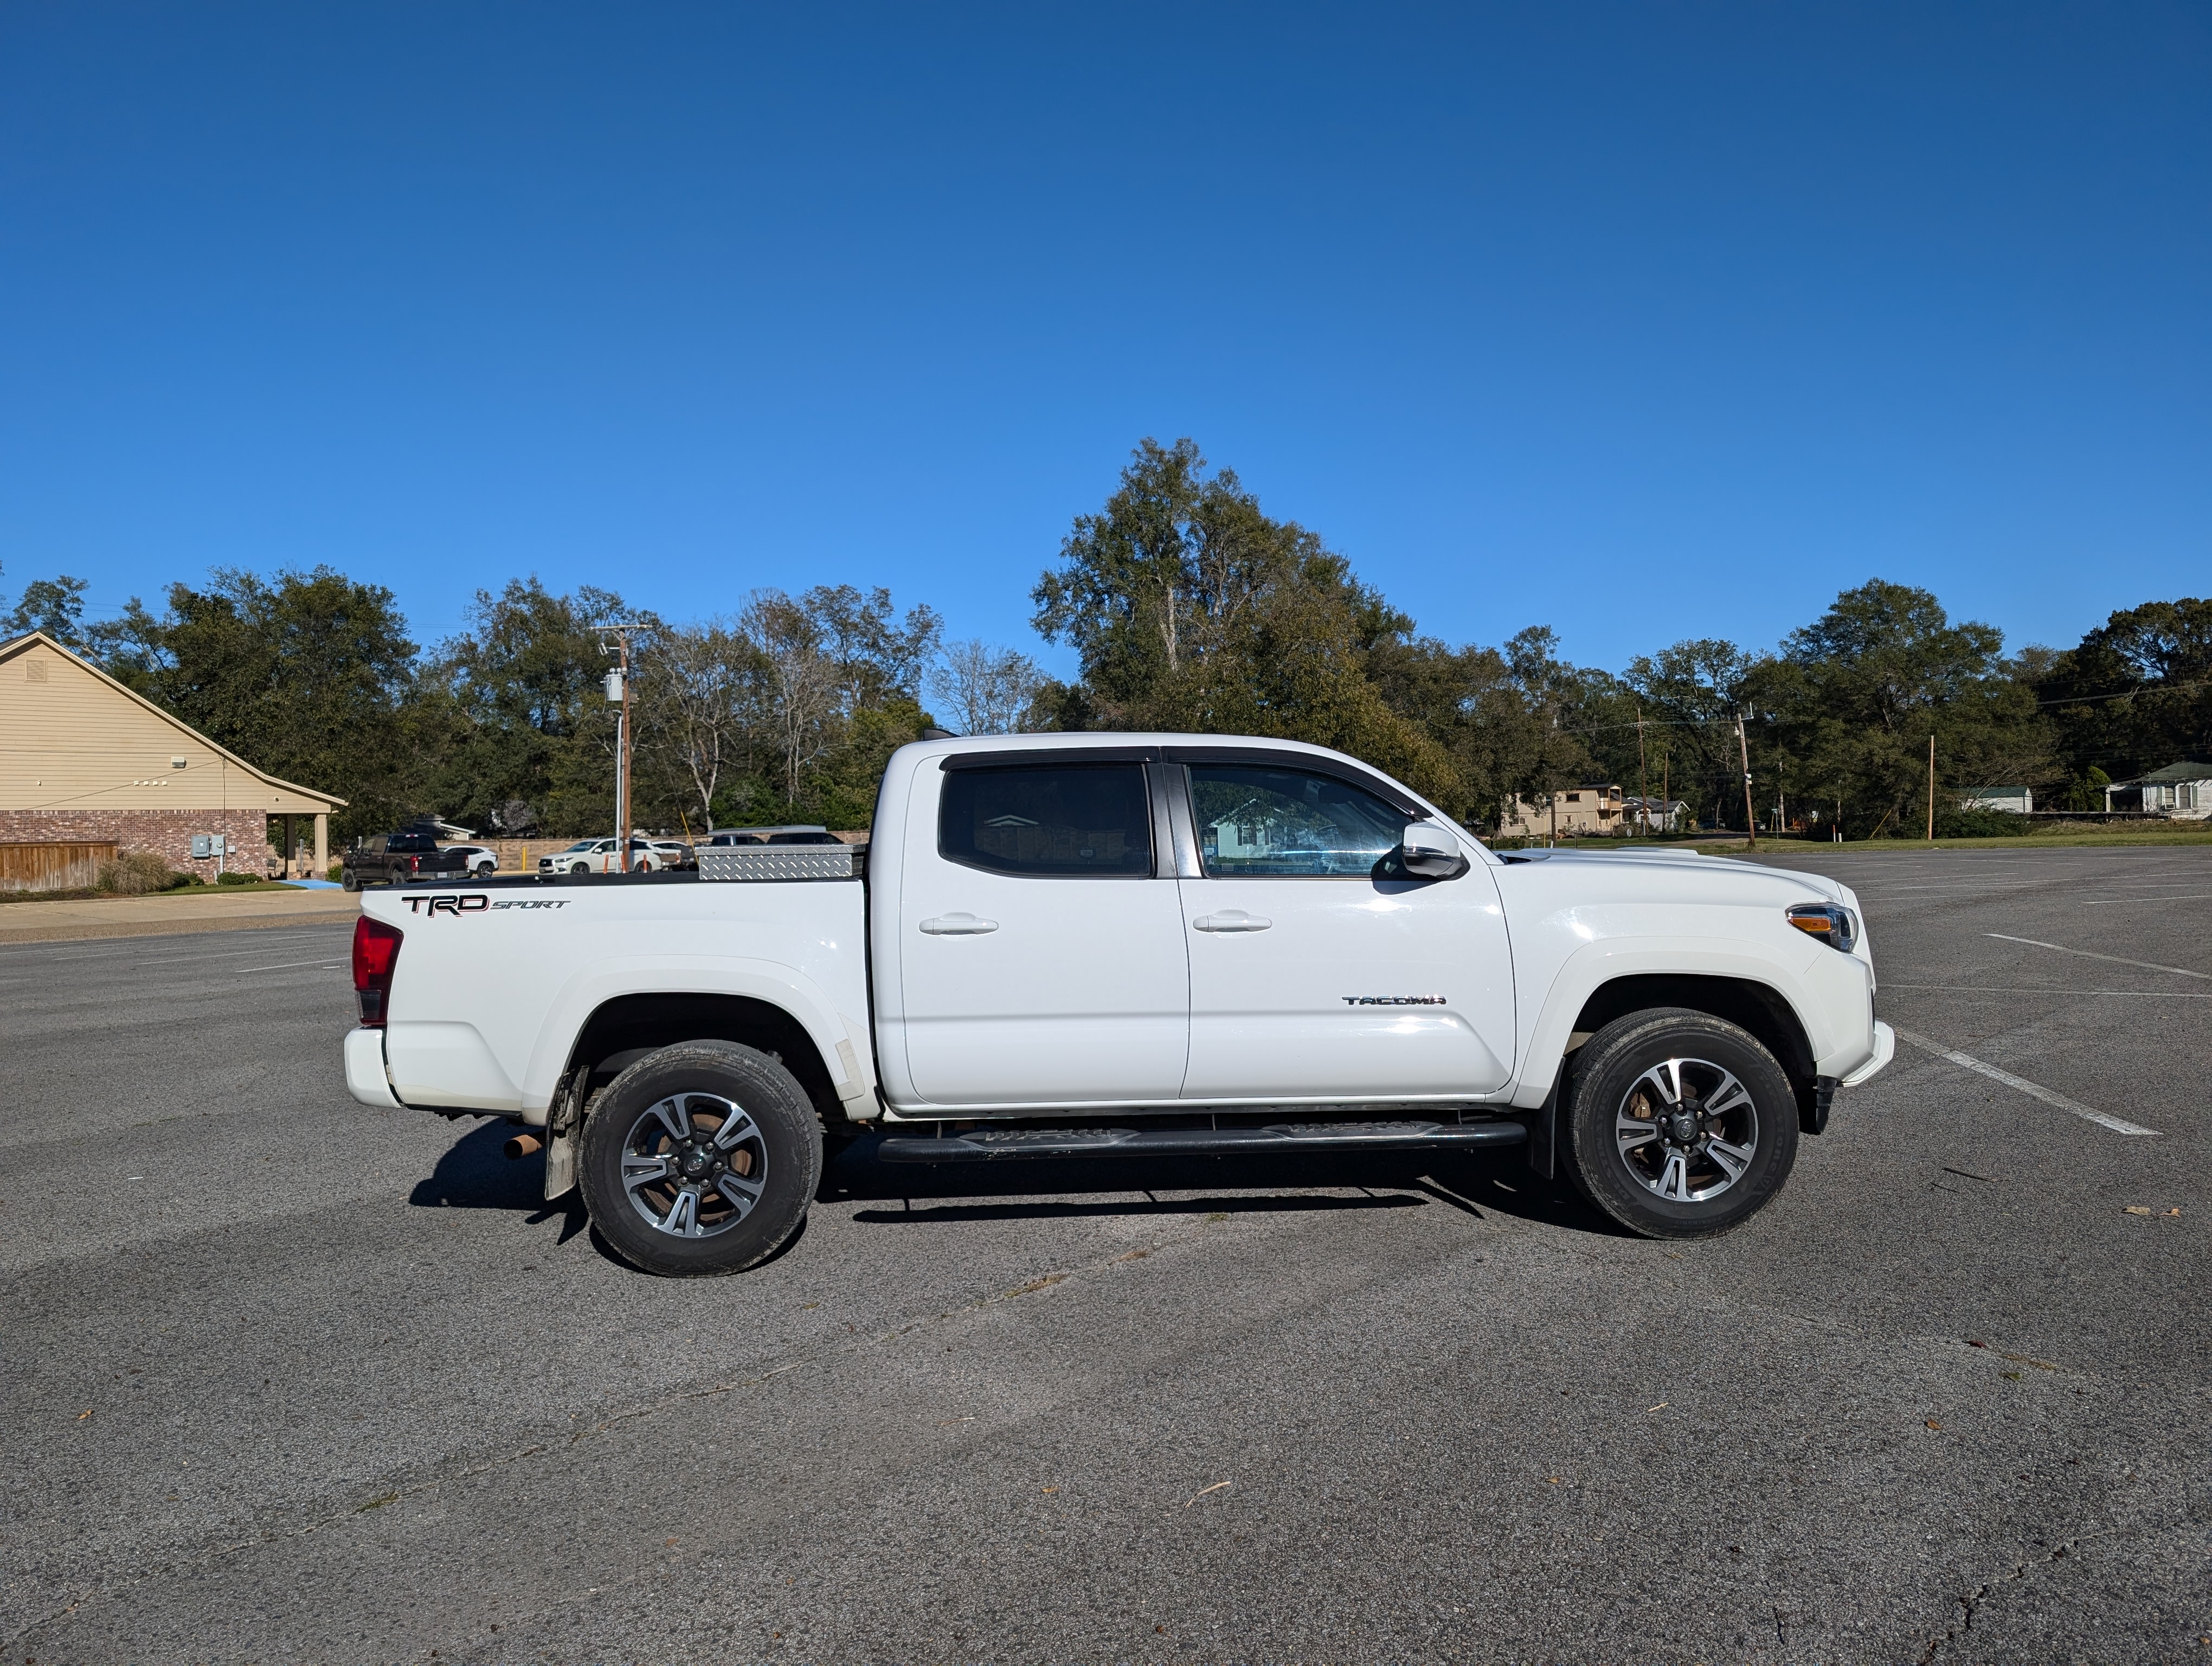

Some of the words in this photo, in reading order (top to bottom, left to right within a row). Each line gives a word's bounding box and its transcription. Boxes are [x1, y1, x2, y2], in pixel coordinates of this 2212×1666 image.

[402, 895, 490, 918] TRD
[490, 900, 571, 909] SPORT
[1342, 996, 1446, 1005] TACOMA
